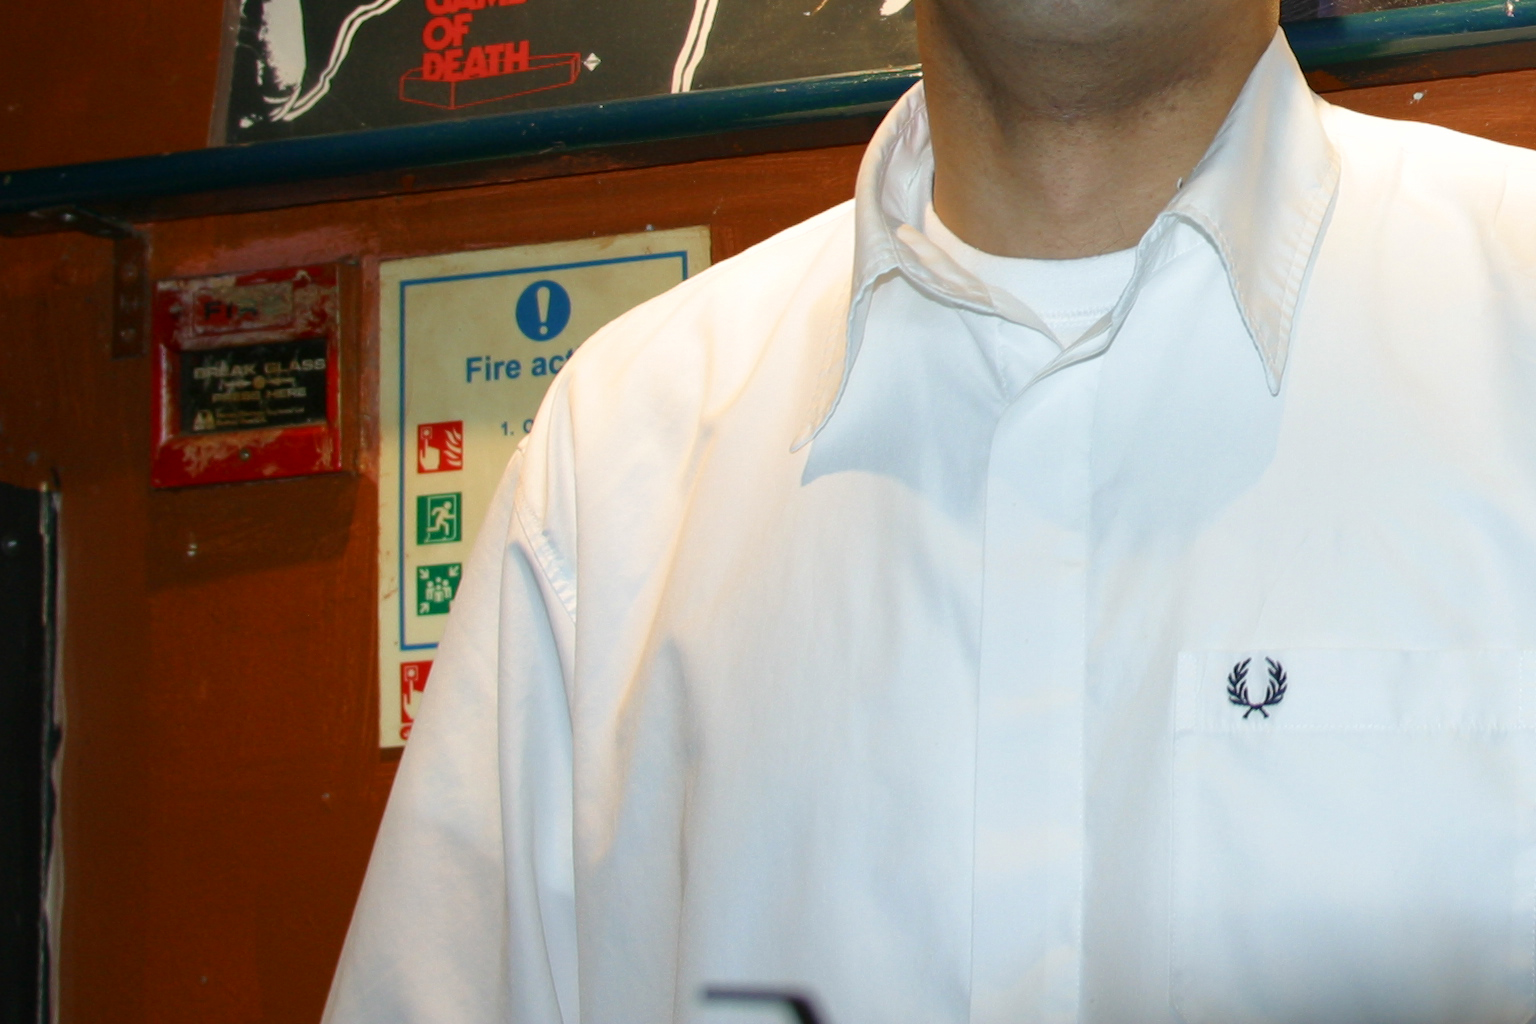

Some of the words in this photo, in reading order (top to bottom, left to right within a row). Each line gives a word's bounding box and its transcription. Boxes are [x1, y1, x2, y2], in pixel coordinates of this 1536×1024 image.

[422, 13, 473, 51] OF
[422, 40, 530, 82] DEATH
[466, 354, 522, 383] Fire
